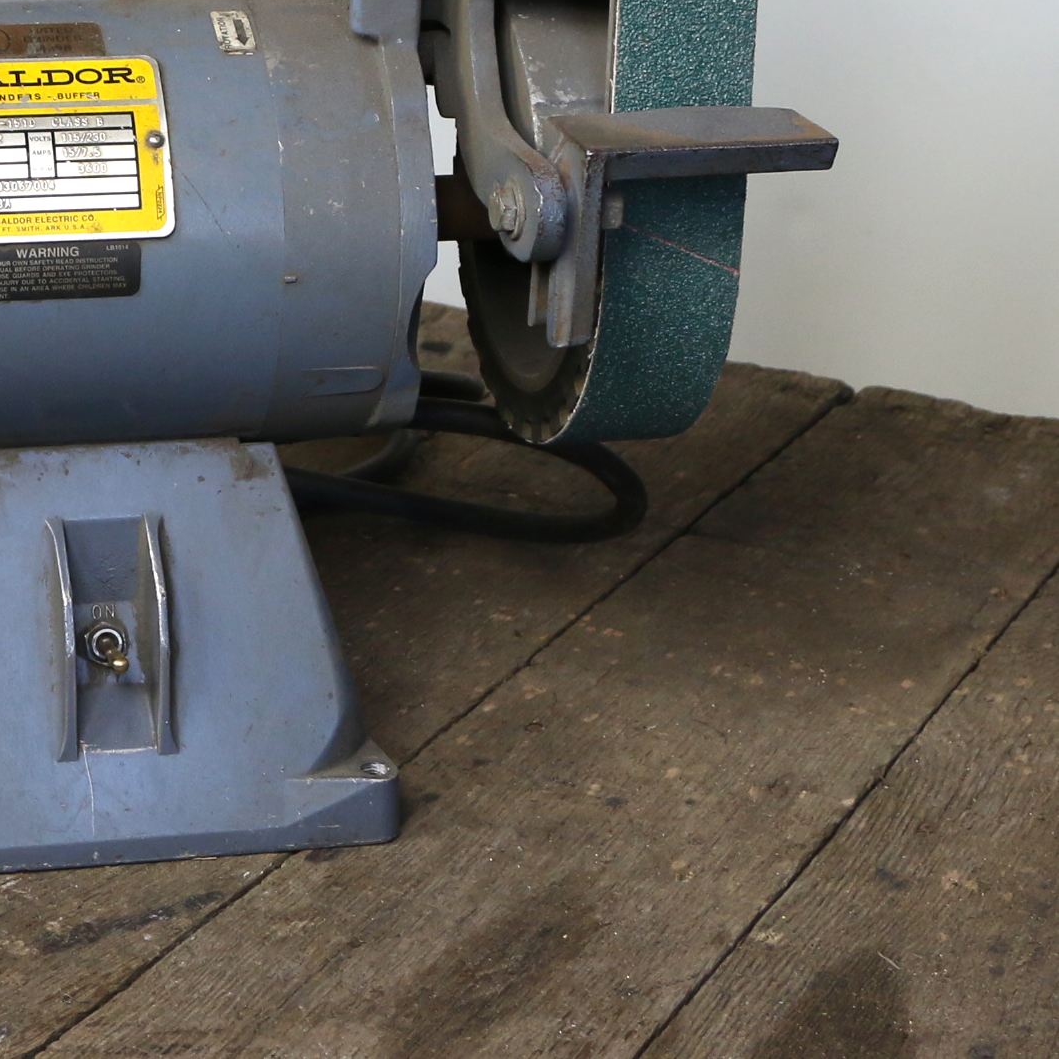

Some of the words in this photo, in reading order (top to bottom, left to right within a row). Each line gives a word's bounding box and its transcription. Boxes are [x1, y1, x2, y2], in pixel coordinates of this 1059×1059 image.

[57, 91, 101, 100] BUFFER
[51, 117, 89, 128] CLASS
[96, 117, 105, 127] B
[61, 132, 107, 143] 115/230
[62, 147, 102, 158] 15/7.5
[78, 163, 108, 174] 3600
[35, 215, 79, 224] ELECTRIC
[81, 213, 97, 222] CO.
[16, 246, 80, 259] WARNING
[42, 264, 80, 272] OPERATING
[92, 604, 115, 620] ON
